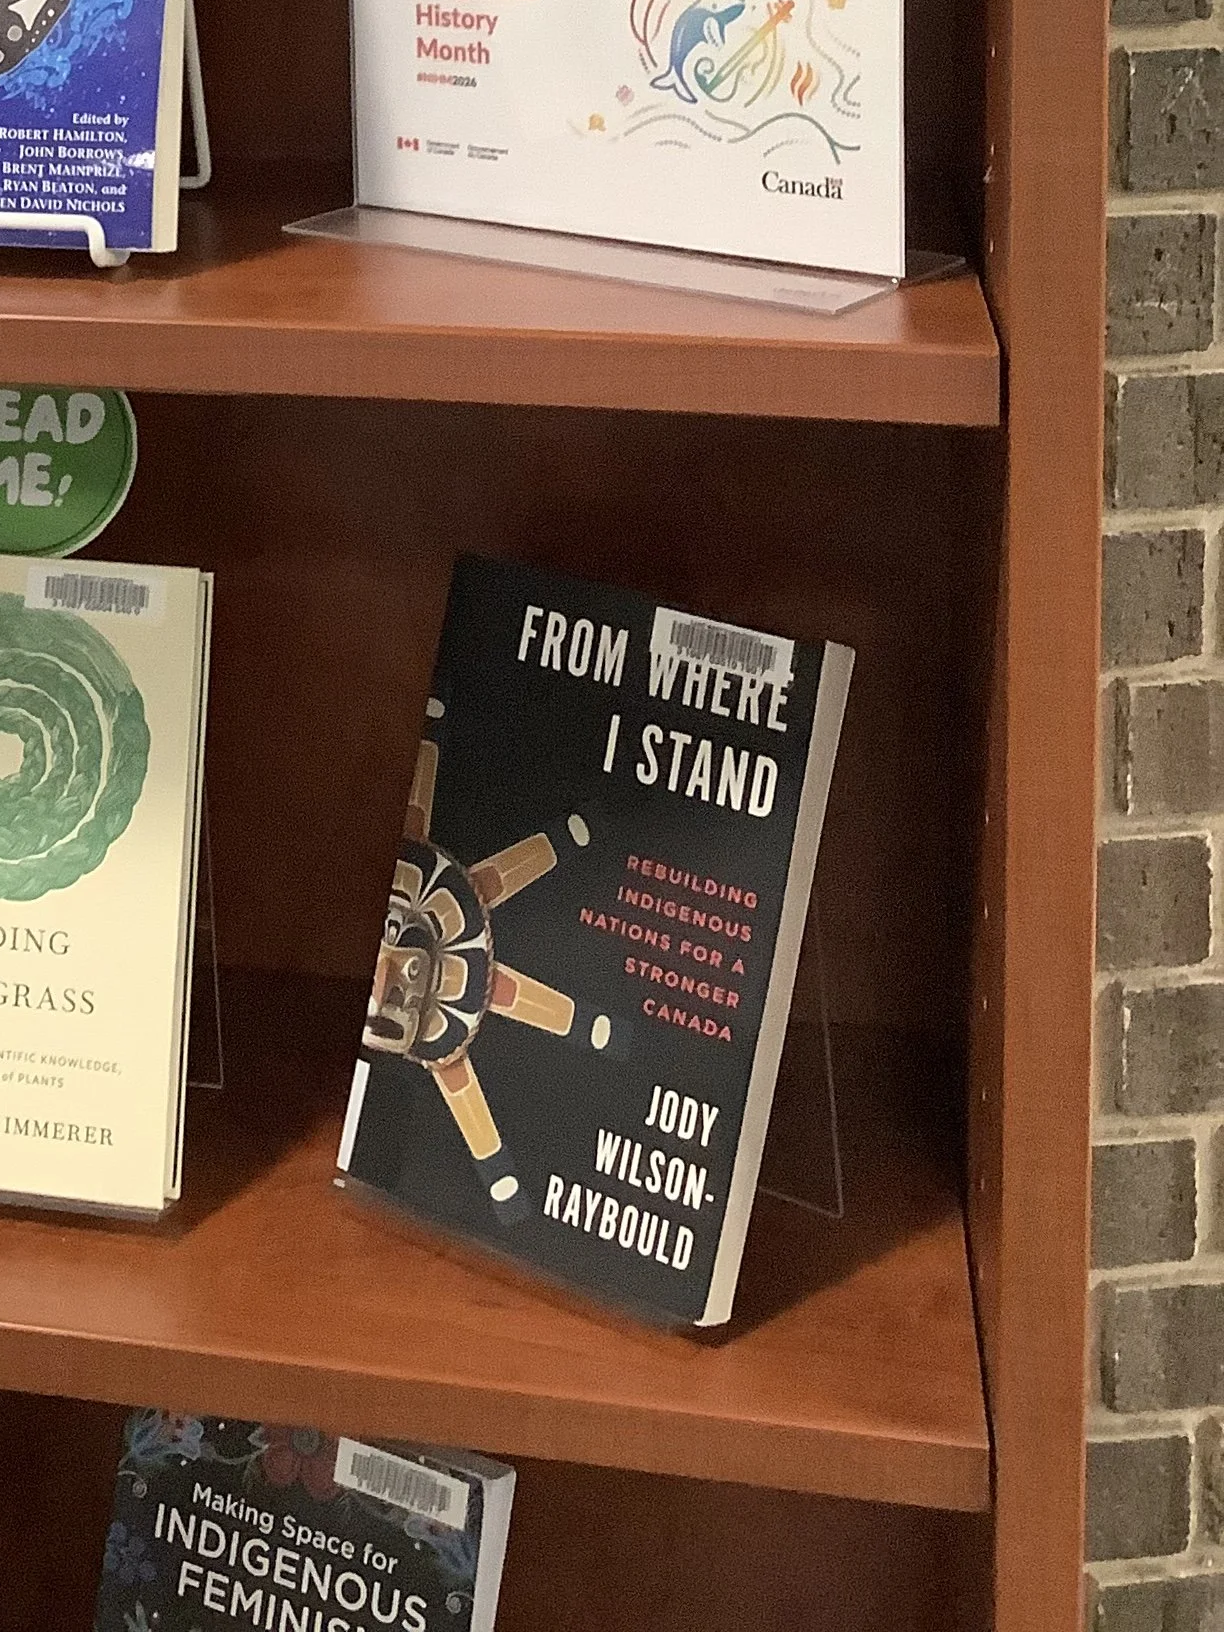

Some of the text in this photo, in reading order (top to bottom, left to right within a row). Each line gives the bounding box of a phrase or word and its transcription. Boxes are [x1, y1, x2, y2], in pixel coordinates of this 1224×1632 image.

[416, 3, 499, 35] History
[416, 37, 490, 65] Month
[53, 128, 128, 143] HAMILTON,
[73, 113, 130, 128] Edited by
[2, 162, 46, 178] BRENT
[19, 145, 54, 159] JOHN
[3, 179, 127, 195] RYAN BEATON, and
[20, 197, 63, 210] DAVID
[67, 198, 125, 213] NICHOLS
[762, 170, 843, 200] Canada
[517, 604, 794, 732] FROM WHERE
[603, 714, 778, 818] I STAND
[627, 855, 758, 909] REBUILDING
[617, 885, 752, 942] INDIGENOUS
[579, 907, 745, 976] NATIONS FOR A
[624, 957, 739, 1009] STRONGER
[643, 998, 732, 1042] CANADA
[2, 1071, 15, 1081] of
[18, 1073, 65, 1088] PLANTS
[40, 1055, 123, 1076] KNOWLEDGE,
[645, 1085, 719, 1147] JODY
[595, 1128, 714, 1211] WILSON-
[543, 1174, 694, 1271] RAYBOULD
[193, 1482, 398, 1575] Making Space for
[154, 1503, 427, 1632] INDIGENOUS
